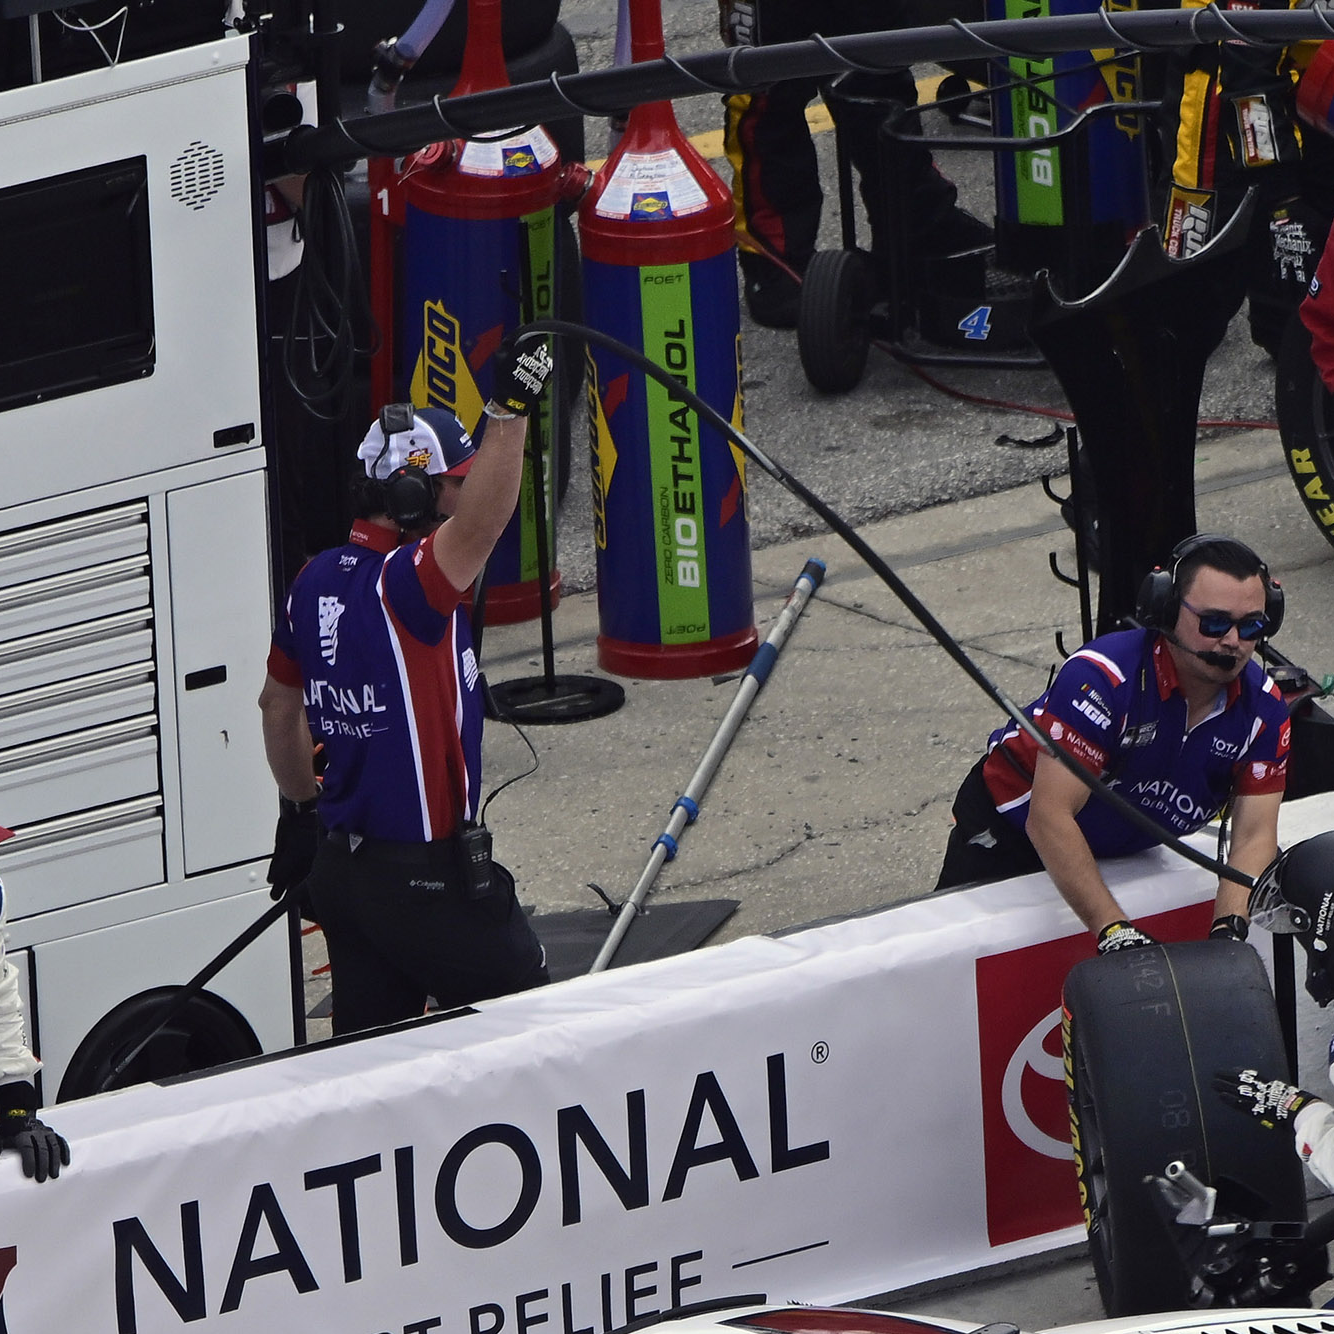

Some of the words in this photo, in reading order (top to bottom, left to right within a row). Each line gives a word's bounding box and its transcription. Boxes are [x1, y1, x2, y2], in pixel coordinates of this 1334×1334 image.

[958, 306, 993, 340] 4
[1072, 698, 1113, 731] JGR
[1131, 780, 1219, 821] NATION
[1315, 890, 1334, 937] NATIONAL
